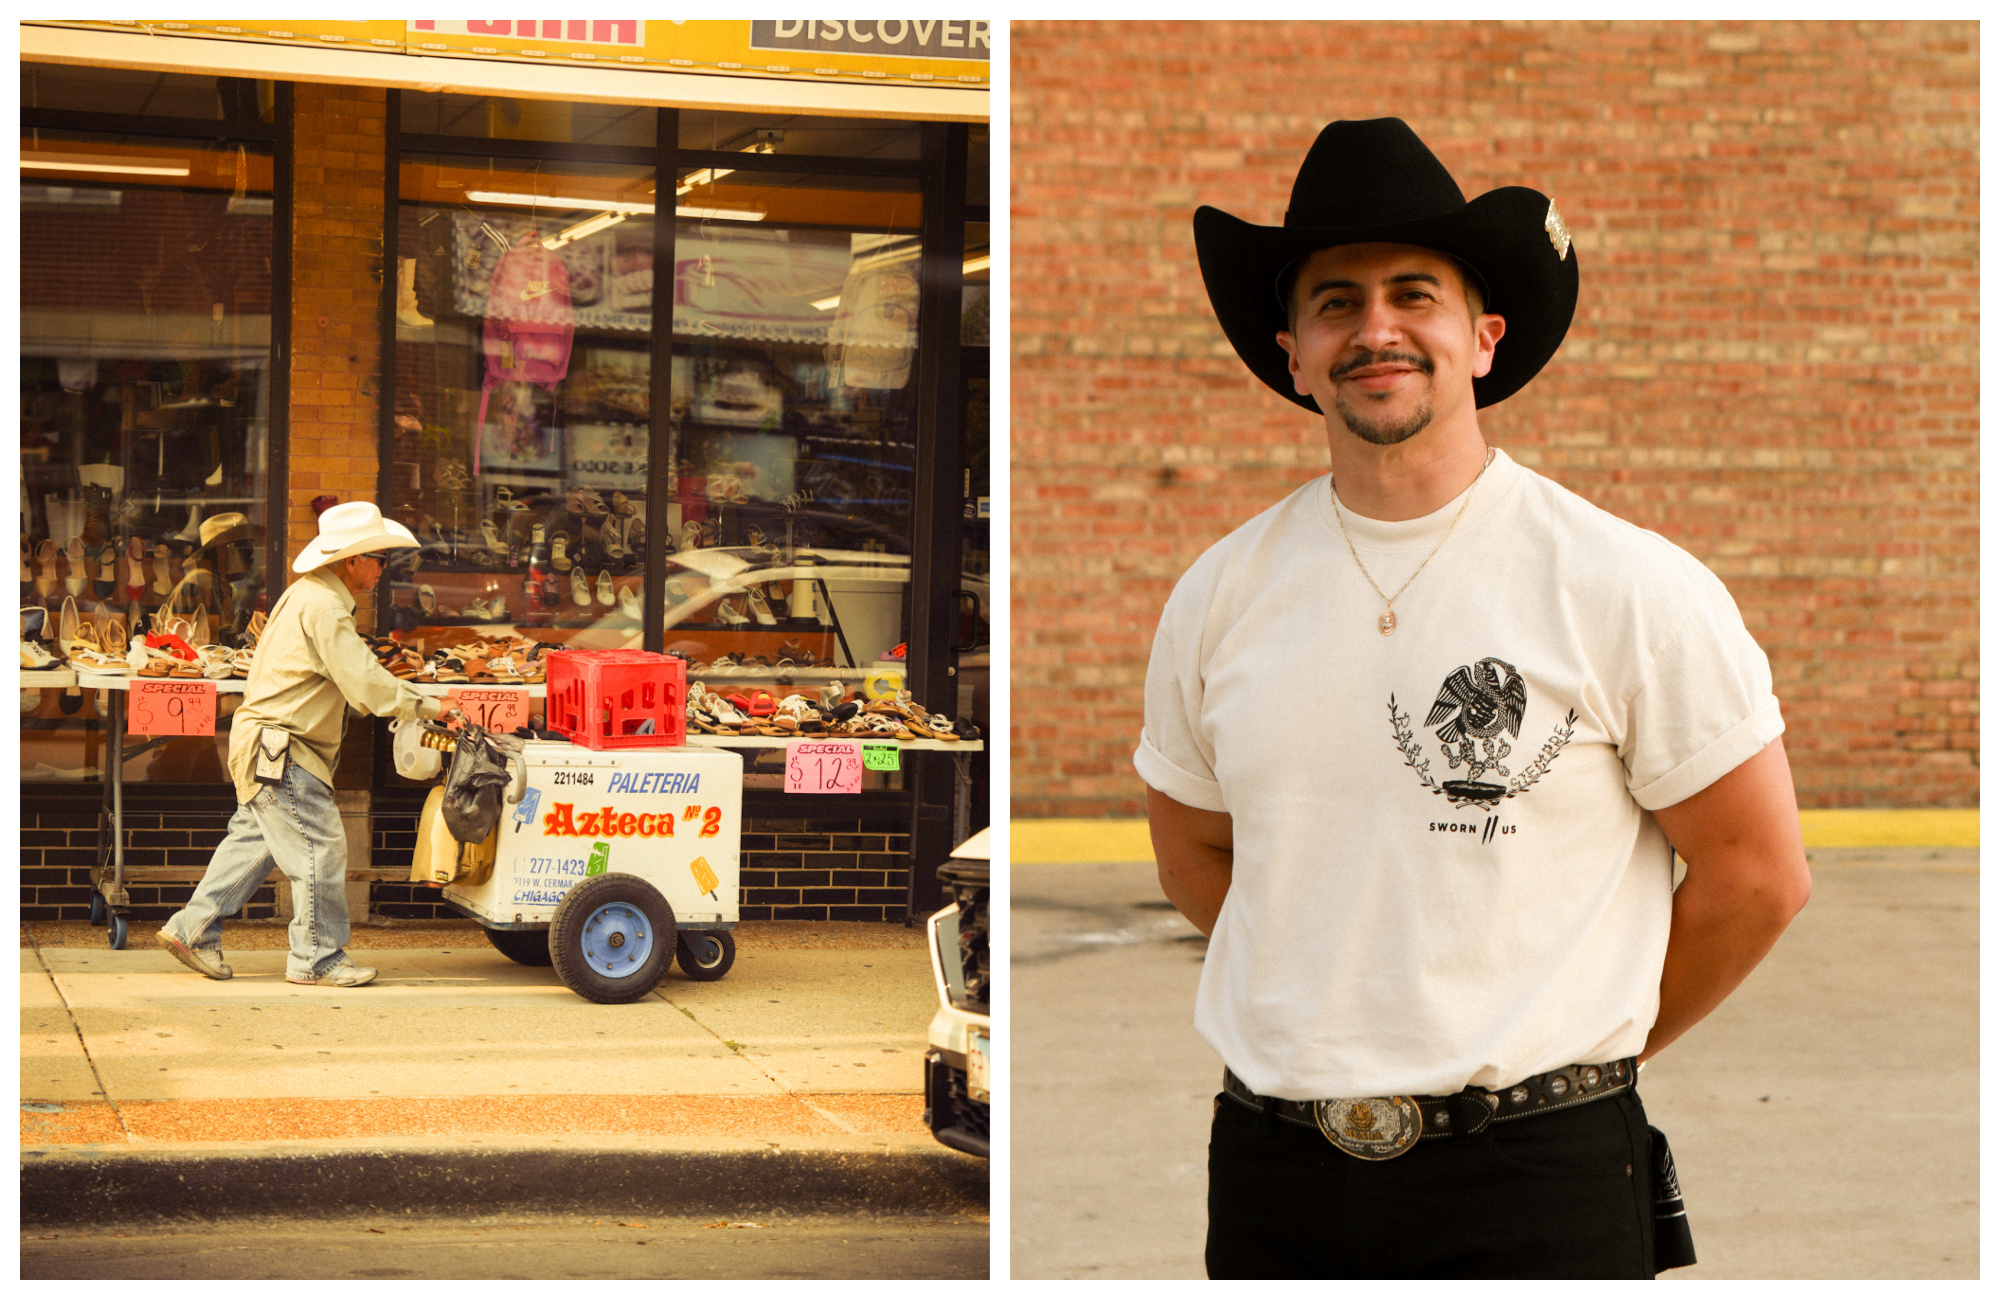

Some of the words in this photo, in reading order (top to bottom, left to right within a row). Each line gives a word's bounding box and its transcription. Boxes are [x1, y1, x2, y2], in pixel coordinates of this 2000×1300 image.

[526, 280, 550, 292] NIKE
[142, 683, 205, 695] SPECIAL
[460, 690, 519, 702] SPECIAL
[798, 744, 854, 755] SPECIAL
[553, 772, 594, 786] 2211484
[607, 772, 700, 794] PALETERIA
[543, 801, 675, 839] Azteca
[699, 806, 722, 839] 2
[1429, 822, 1477, 834] SWORN
[1502, 825, 1517, 834] US
[529, 857, 585, 876] 277-1423
[543, 878, 574, 889] CERMAK
